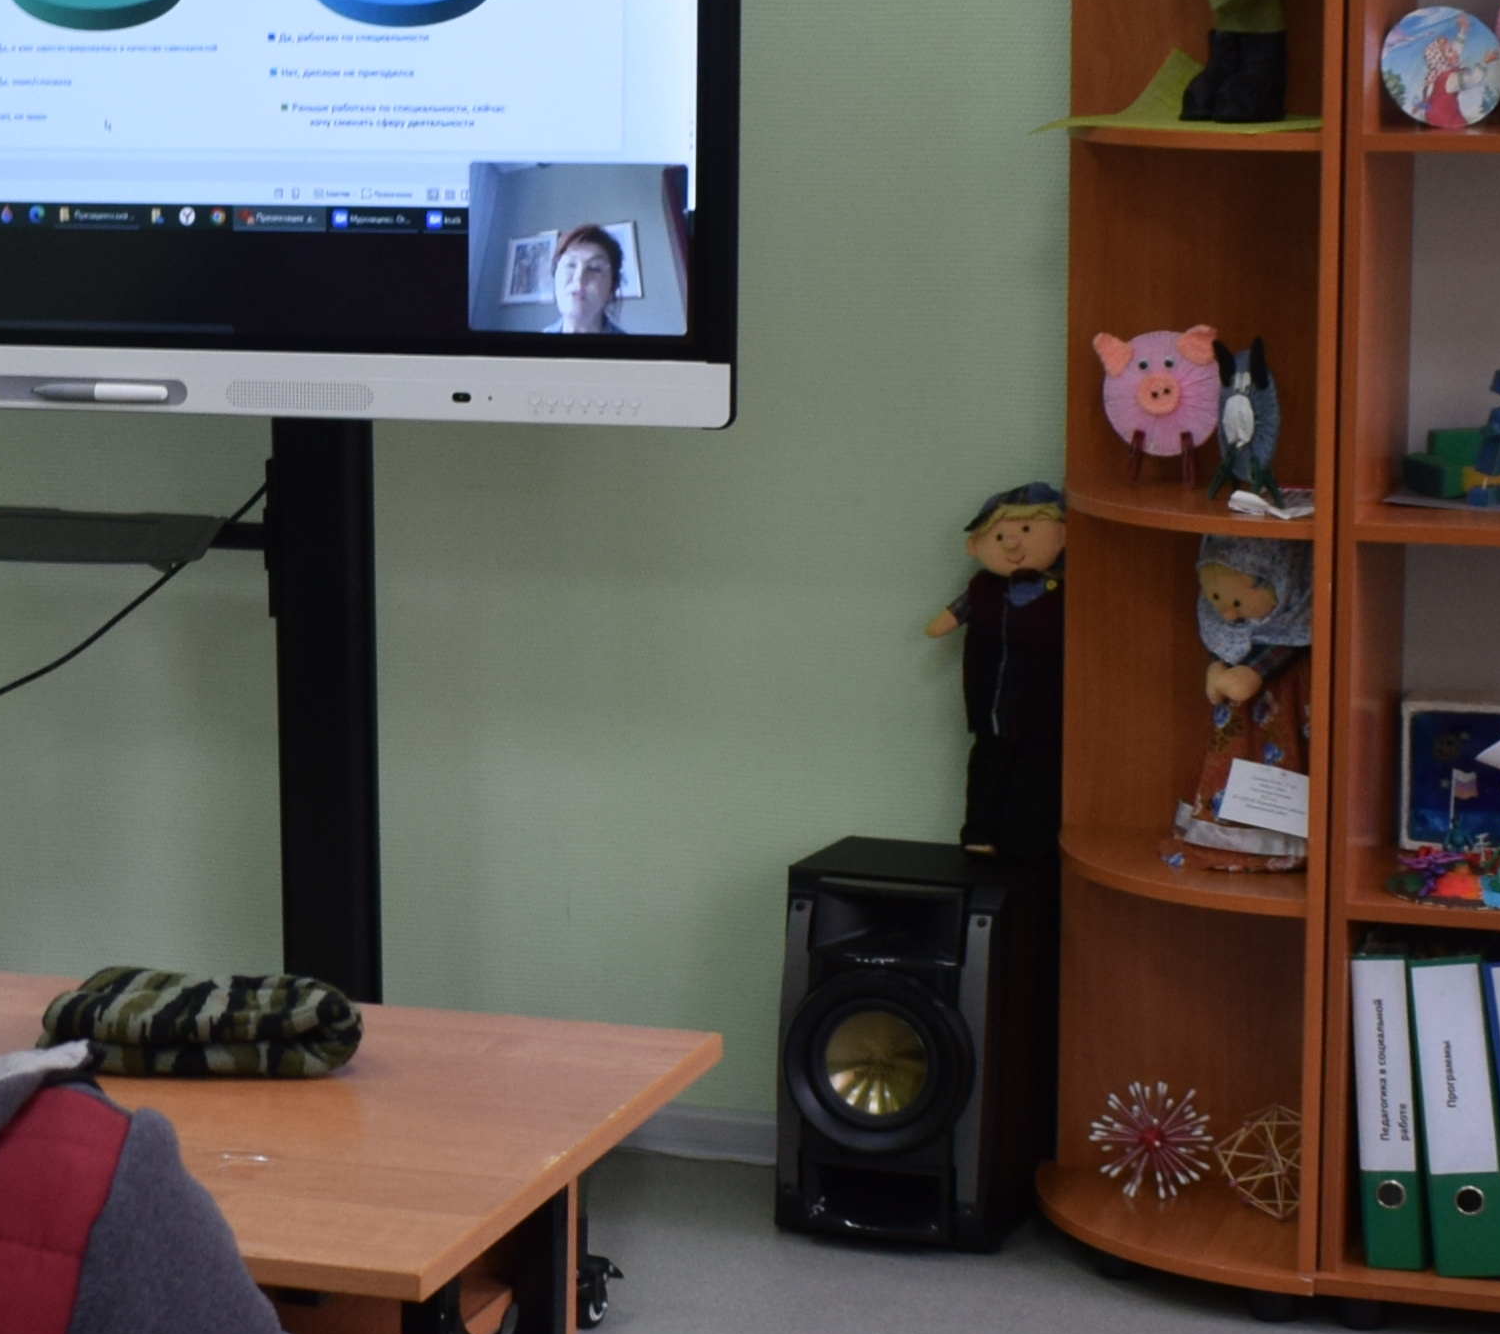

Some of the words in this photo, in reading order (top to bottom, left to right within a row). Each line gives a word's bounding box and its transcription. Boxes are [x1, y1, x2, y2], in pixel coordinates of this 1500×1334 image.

[1373, 998, 1388, 1069] социальной
[1441, 1039, 1458, 1109] Программы
[1379, 1077, 1391, 1142] Педагогика
[1399, 1102, 1412, 1142] работе
